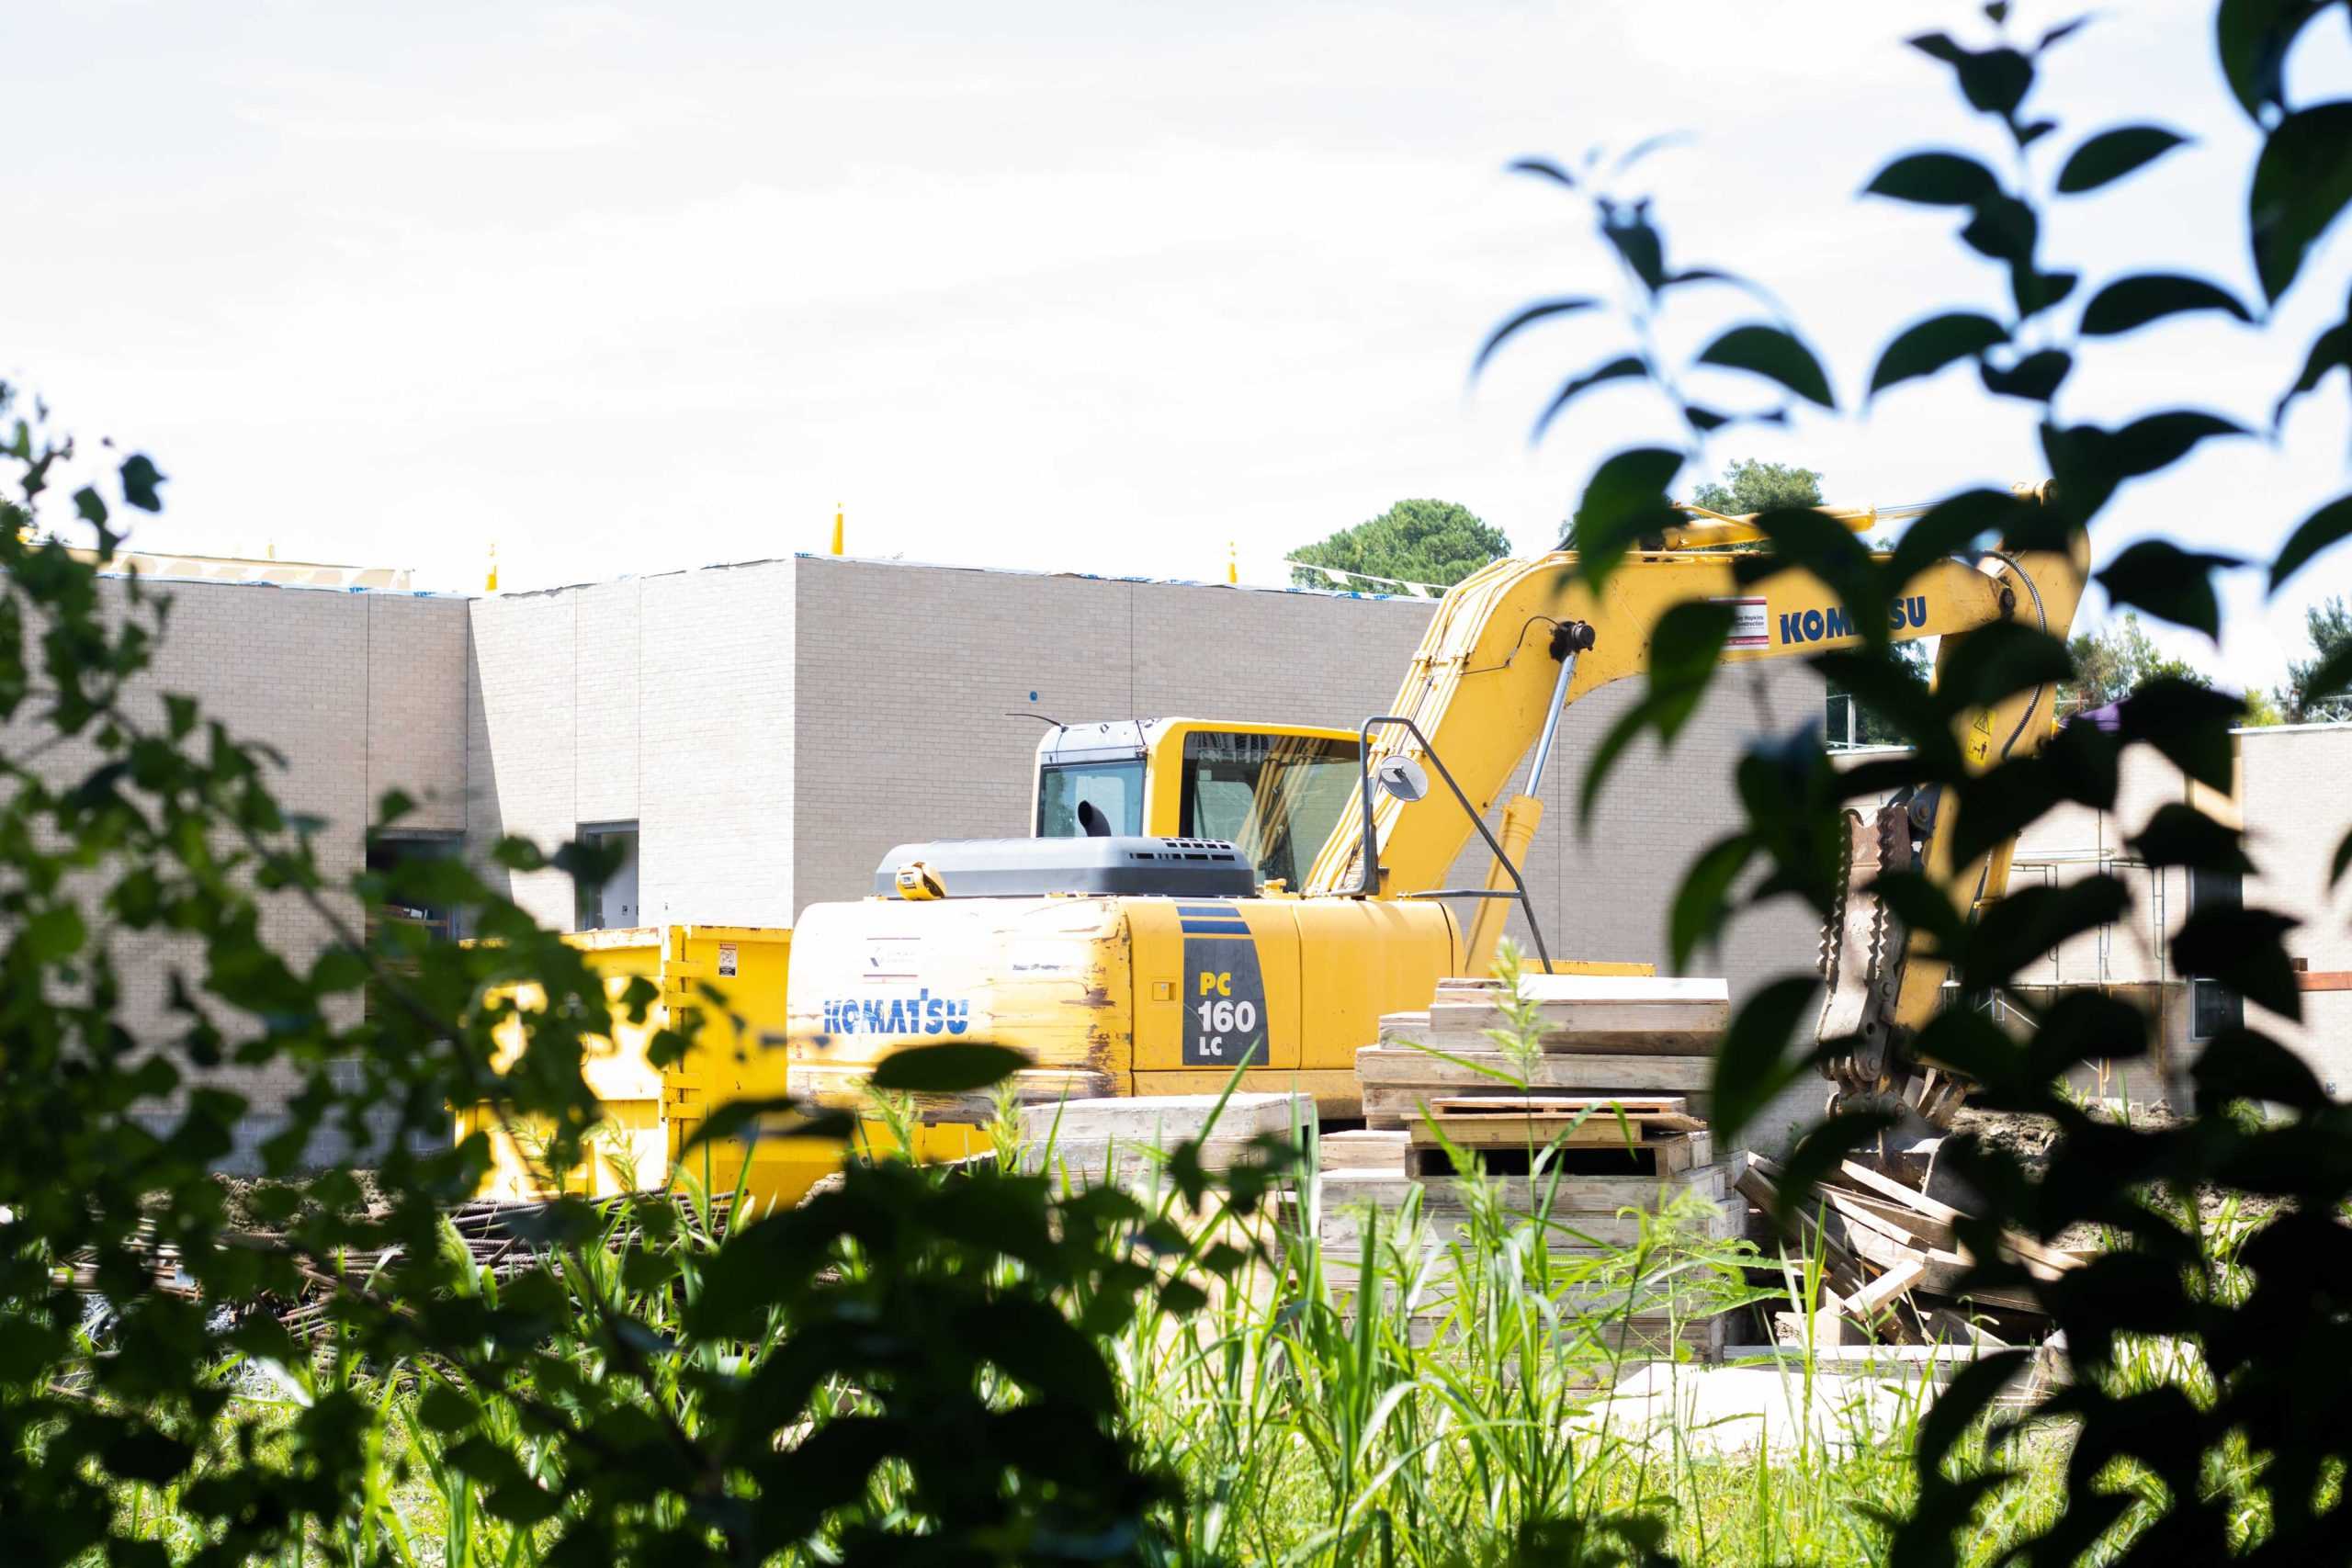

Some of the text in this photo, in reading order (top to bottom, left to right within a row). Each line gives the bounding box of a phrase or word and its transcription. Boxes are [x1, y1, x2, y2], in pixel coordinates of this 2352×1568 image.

[1780, 596, 1927, 644] KOMSU
[1200, 972, 1231, 997] PC
[824, 988, 969, 1034] KOMATSU
[1198, 1000, 1256, 1032] 160
[1199, 1036, 1222, 1055] LC
